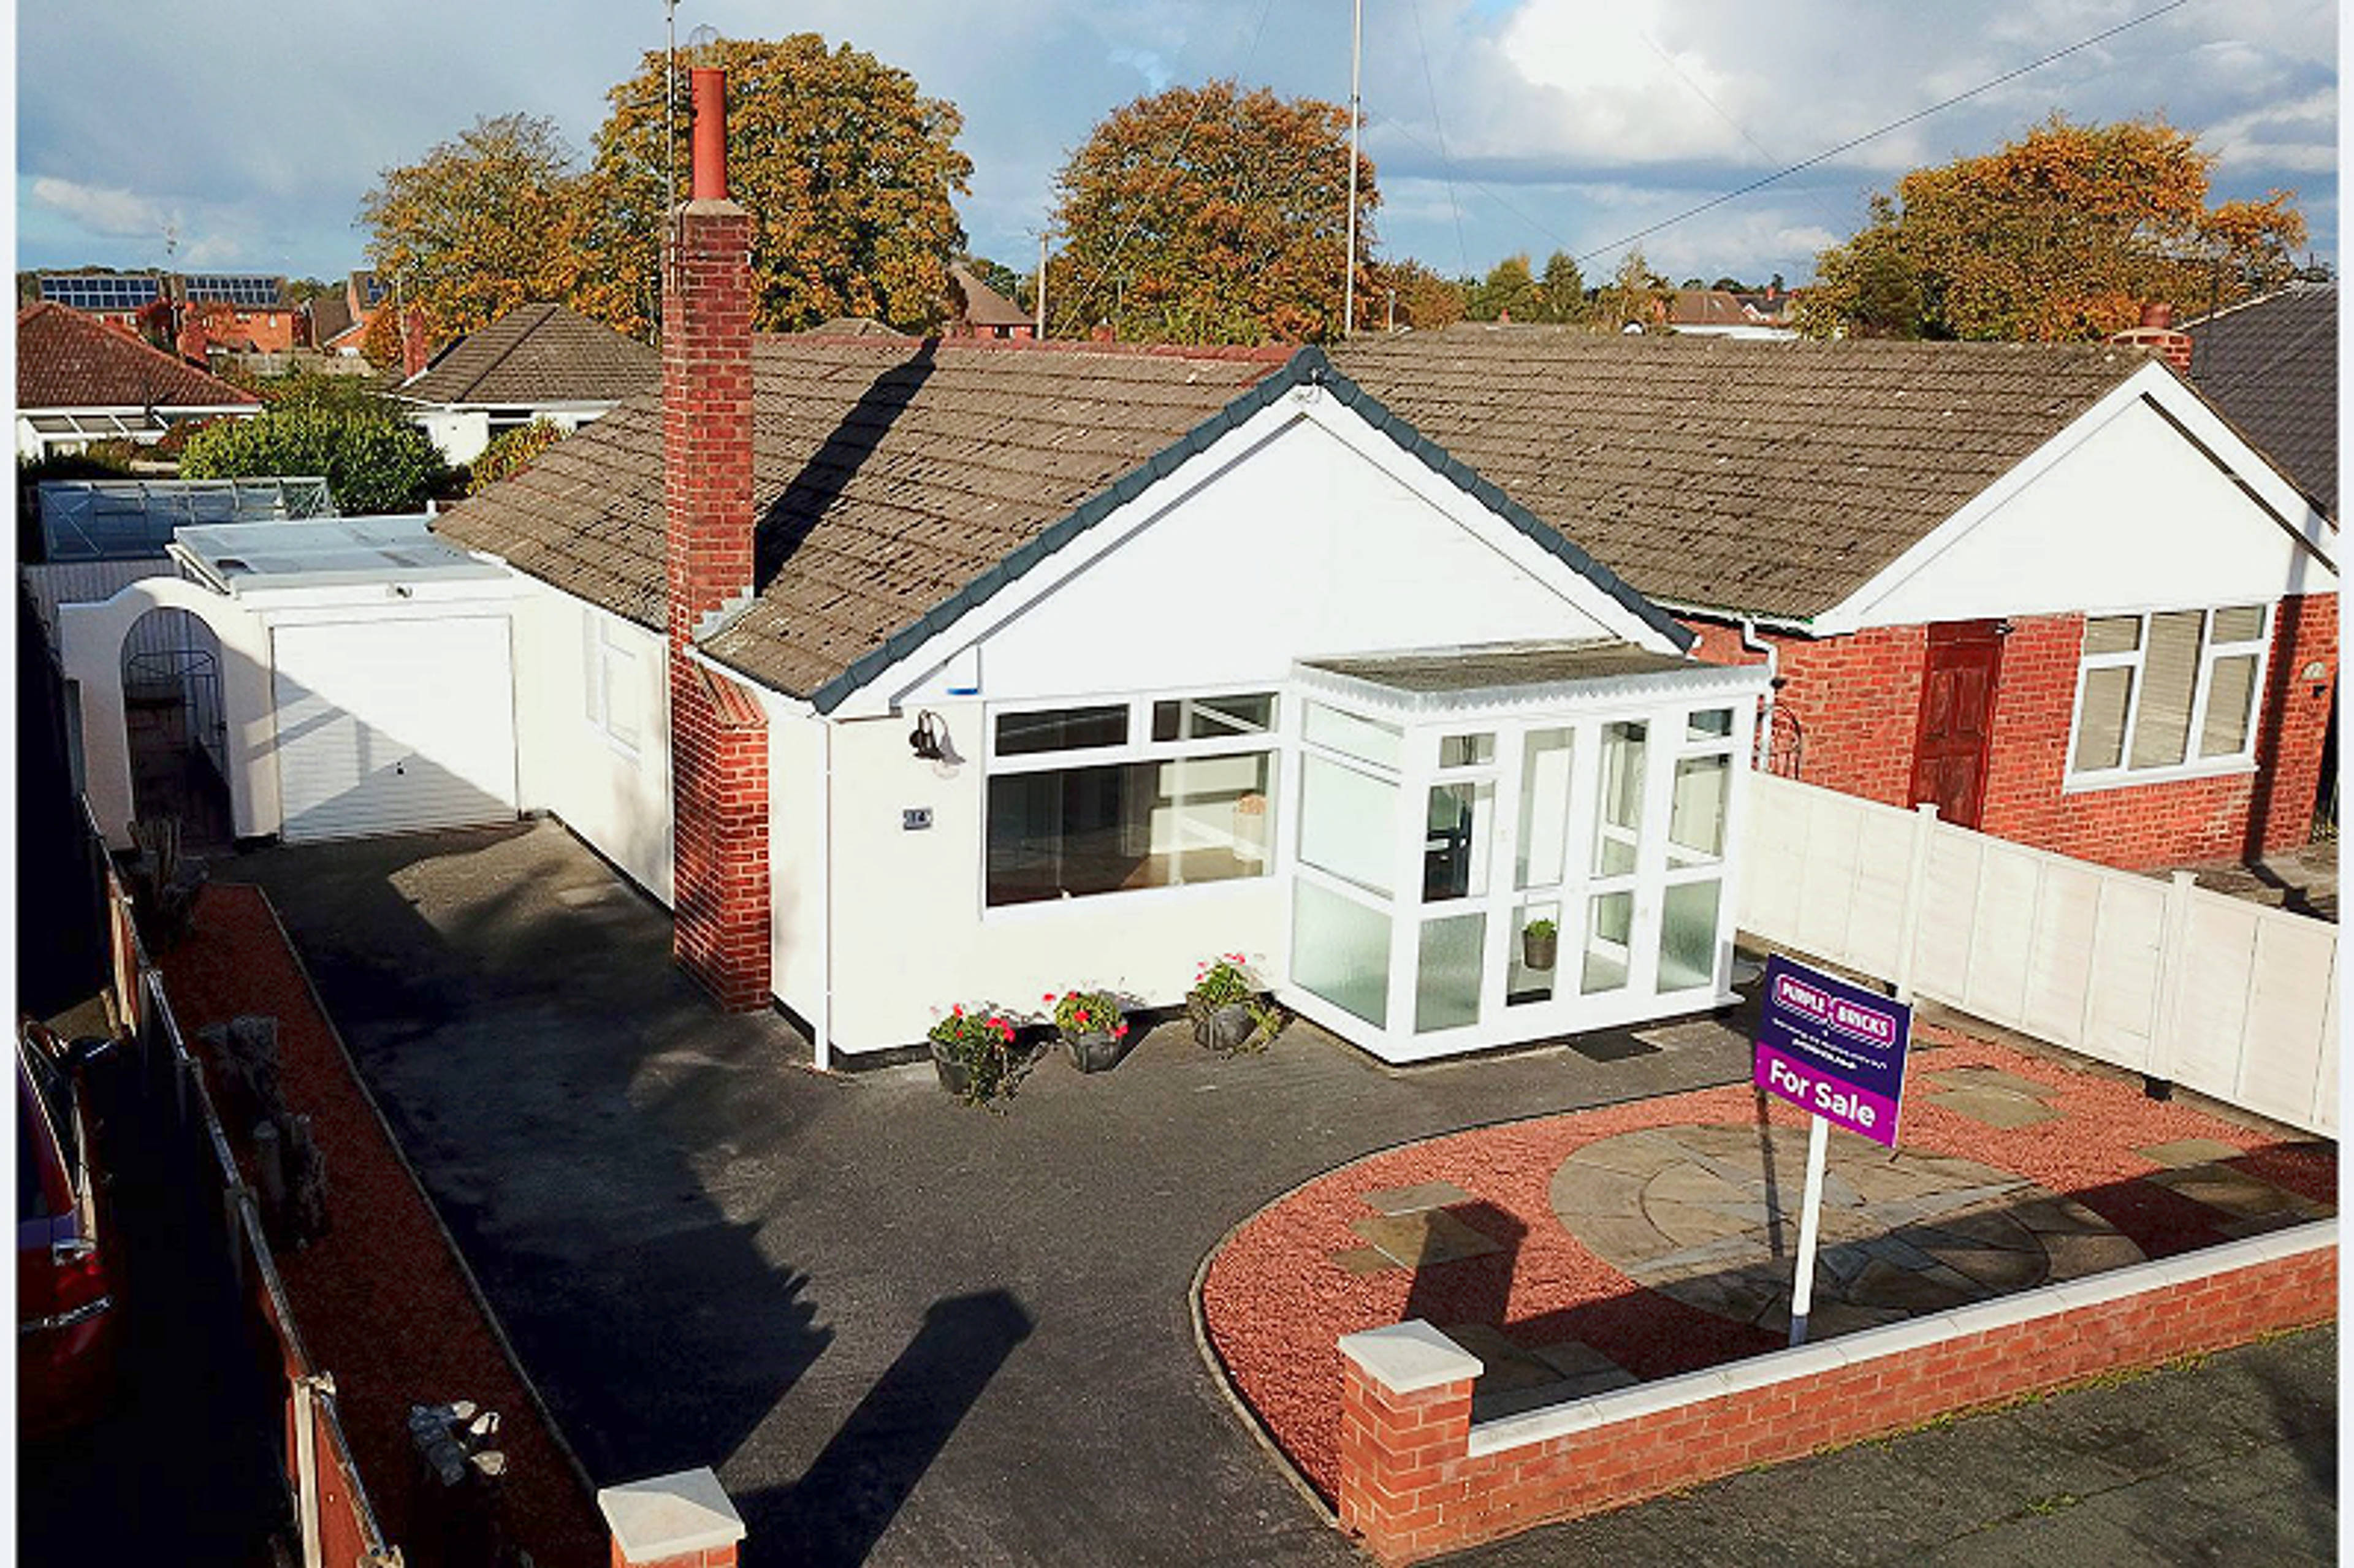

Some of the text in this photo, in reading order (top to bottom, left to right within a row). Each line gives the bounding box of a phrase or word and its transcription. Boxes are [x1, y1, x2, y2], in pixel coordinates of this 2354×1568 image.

[1782, 982, 1888, 1037] PURPLE BRICKS
[1770, 1059, 1876, 1127] For Sale
